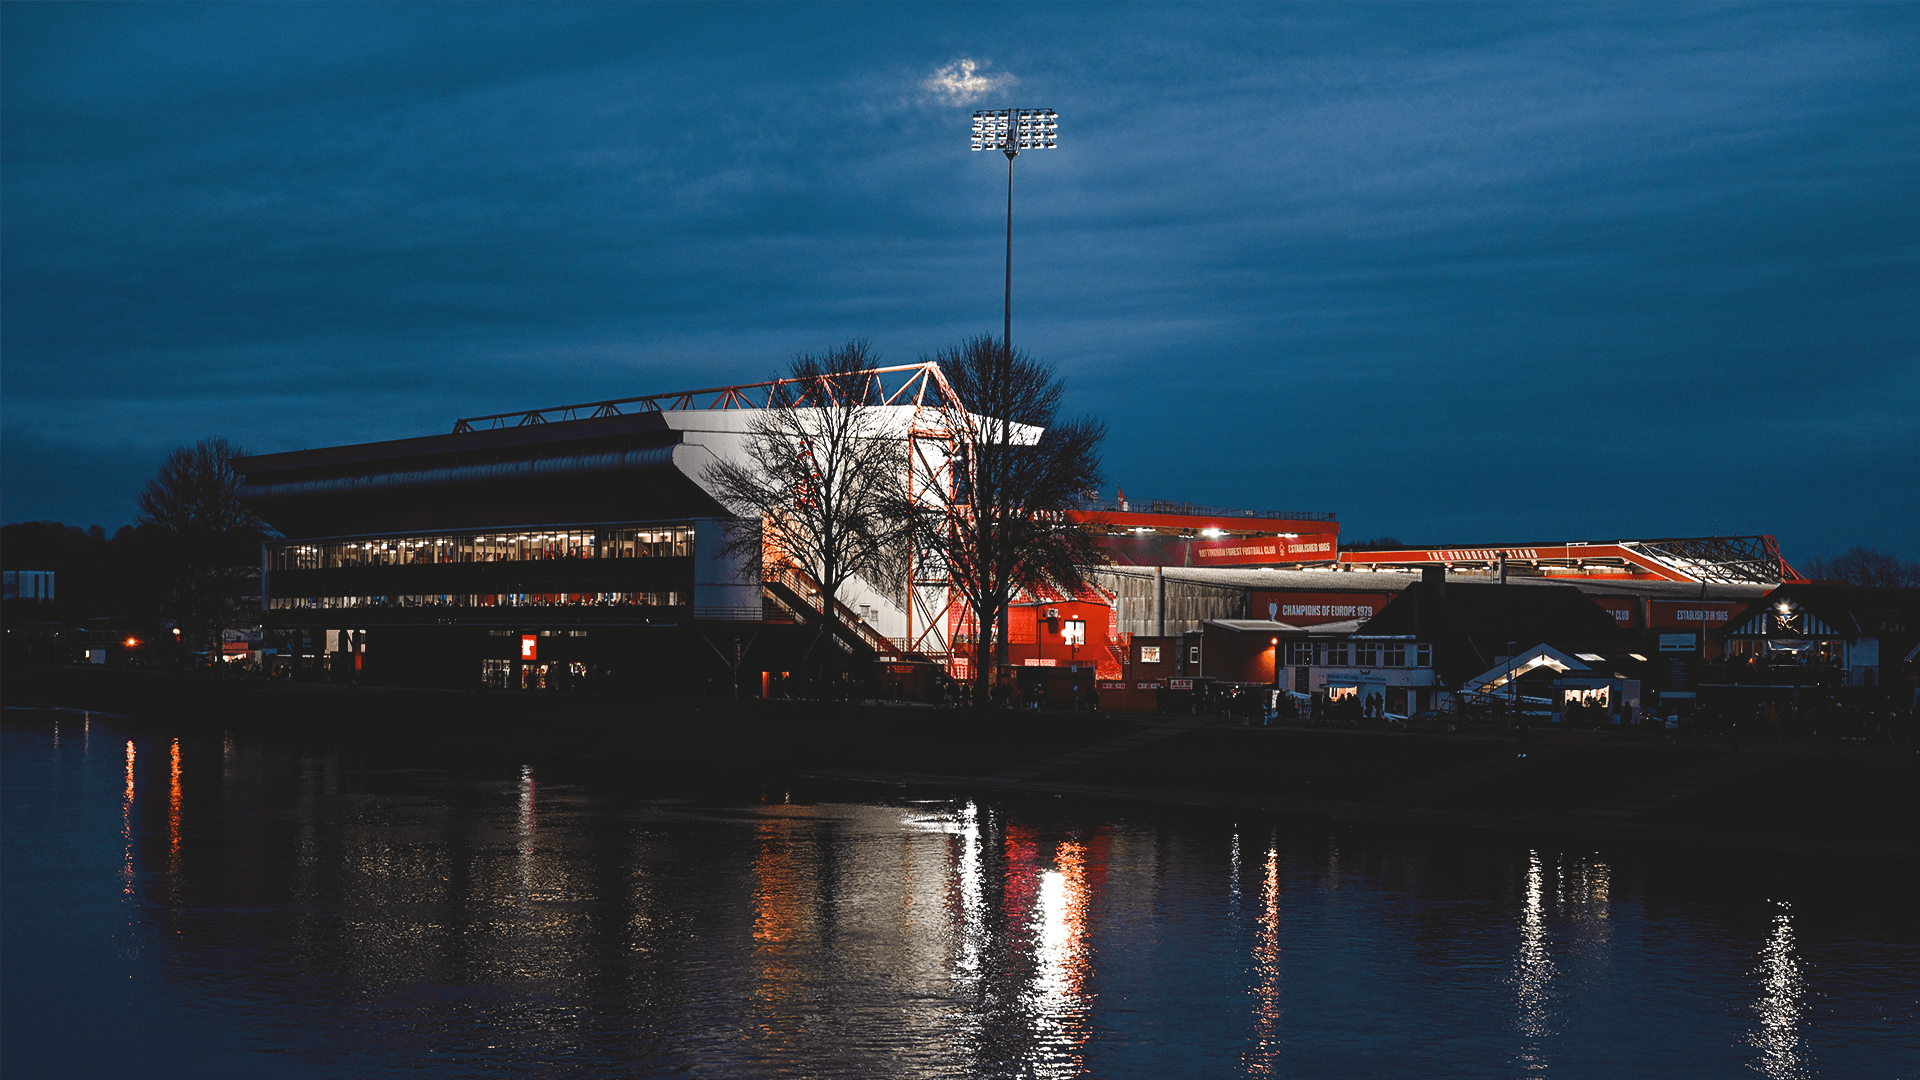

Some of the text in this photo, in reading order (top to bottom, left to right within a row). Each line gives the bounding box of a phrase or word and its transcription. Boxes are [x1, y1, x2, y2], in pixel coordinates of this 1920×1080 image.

[1225, 547, 1242, 556] FOREST
[1242, 546, 1264, 555] FOOTBALL
[1264, 545, 1276, 554] CLUB
[1288, 542, 1330, 553] ESTABLISHED 1865
[1427, 551, 1445, 561] THE
[1506, 549, 1538, 559] STAND
[1282, 604, 1373, 617] CHAMPIONS OF EUROPE 1979
[1615, 610, 1630, 620] CLUB
[1677, 610, 1728, 621] ESTABLISHED IN 1865
